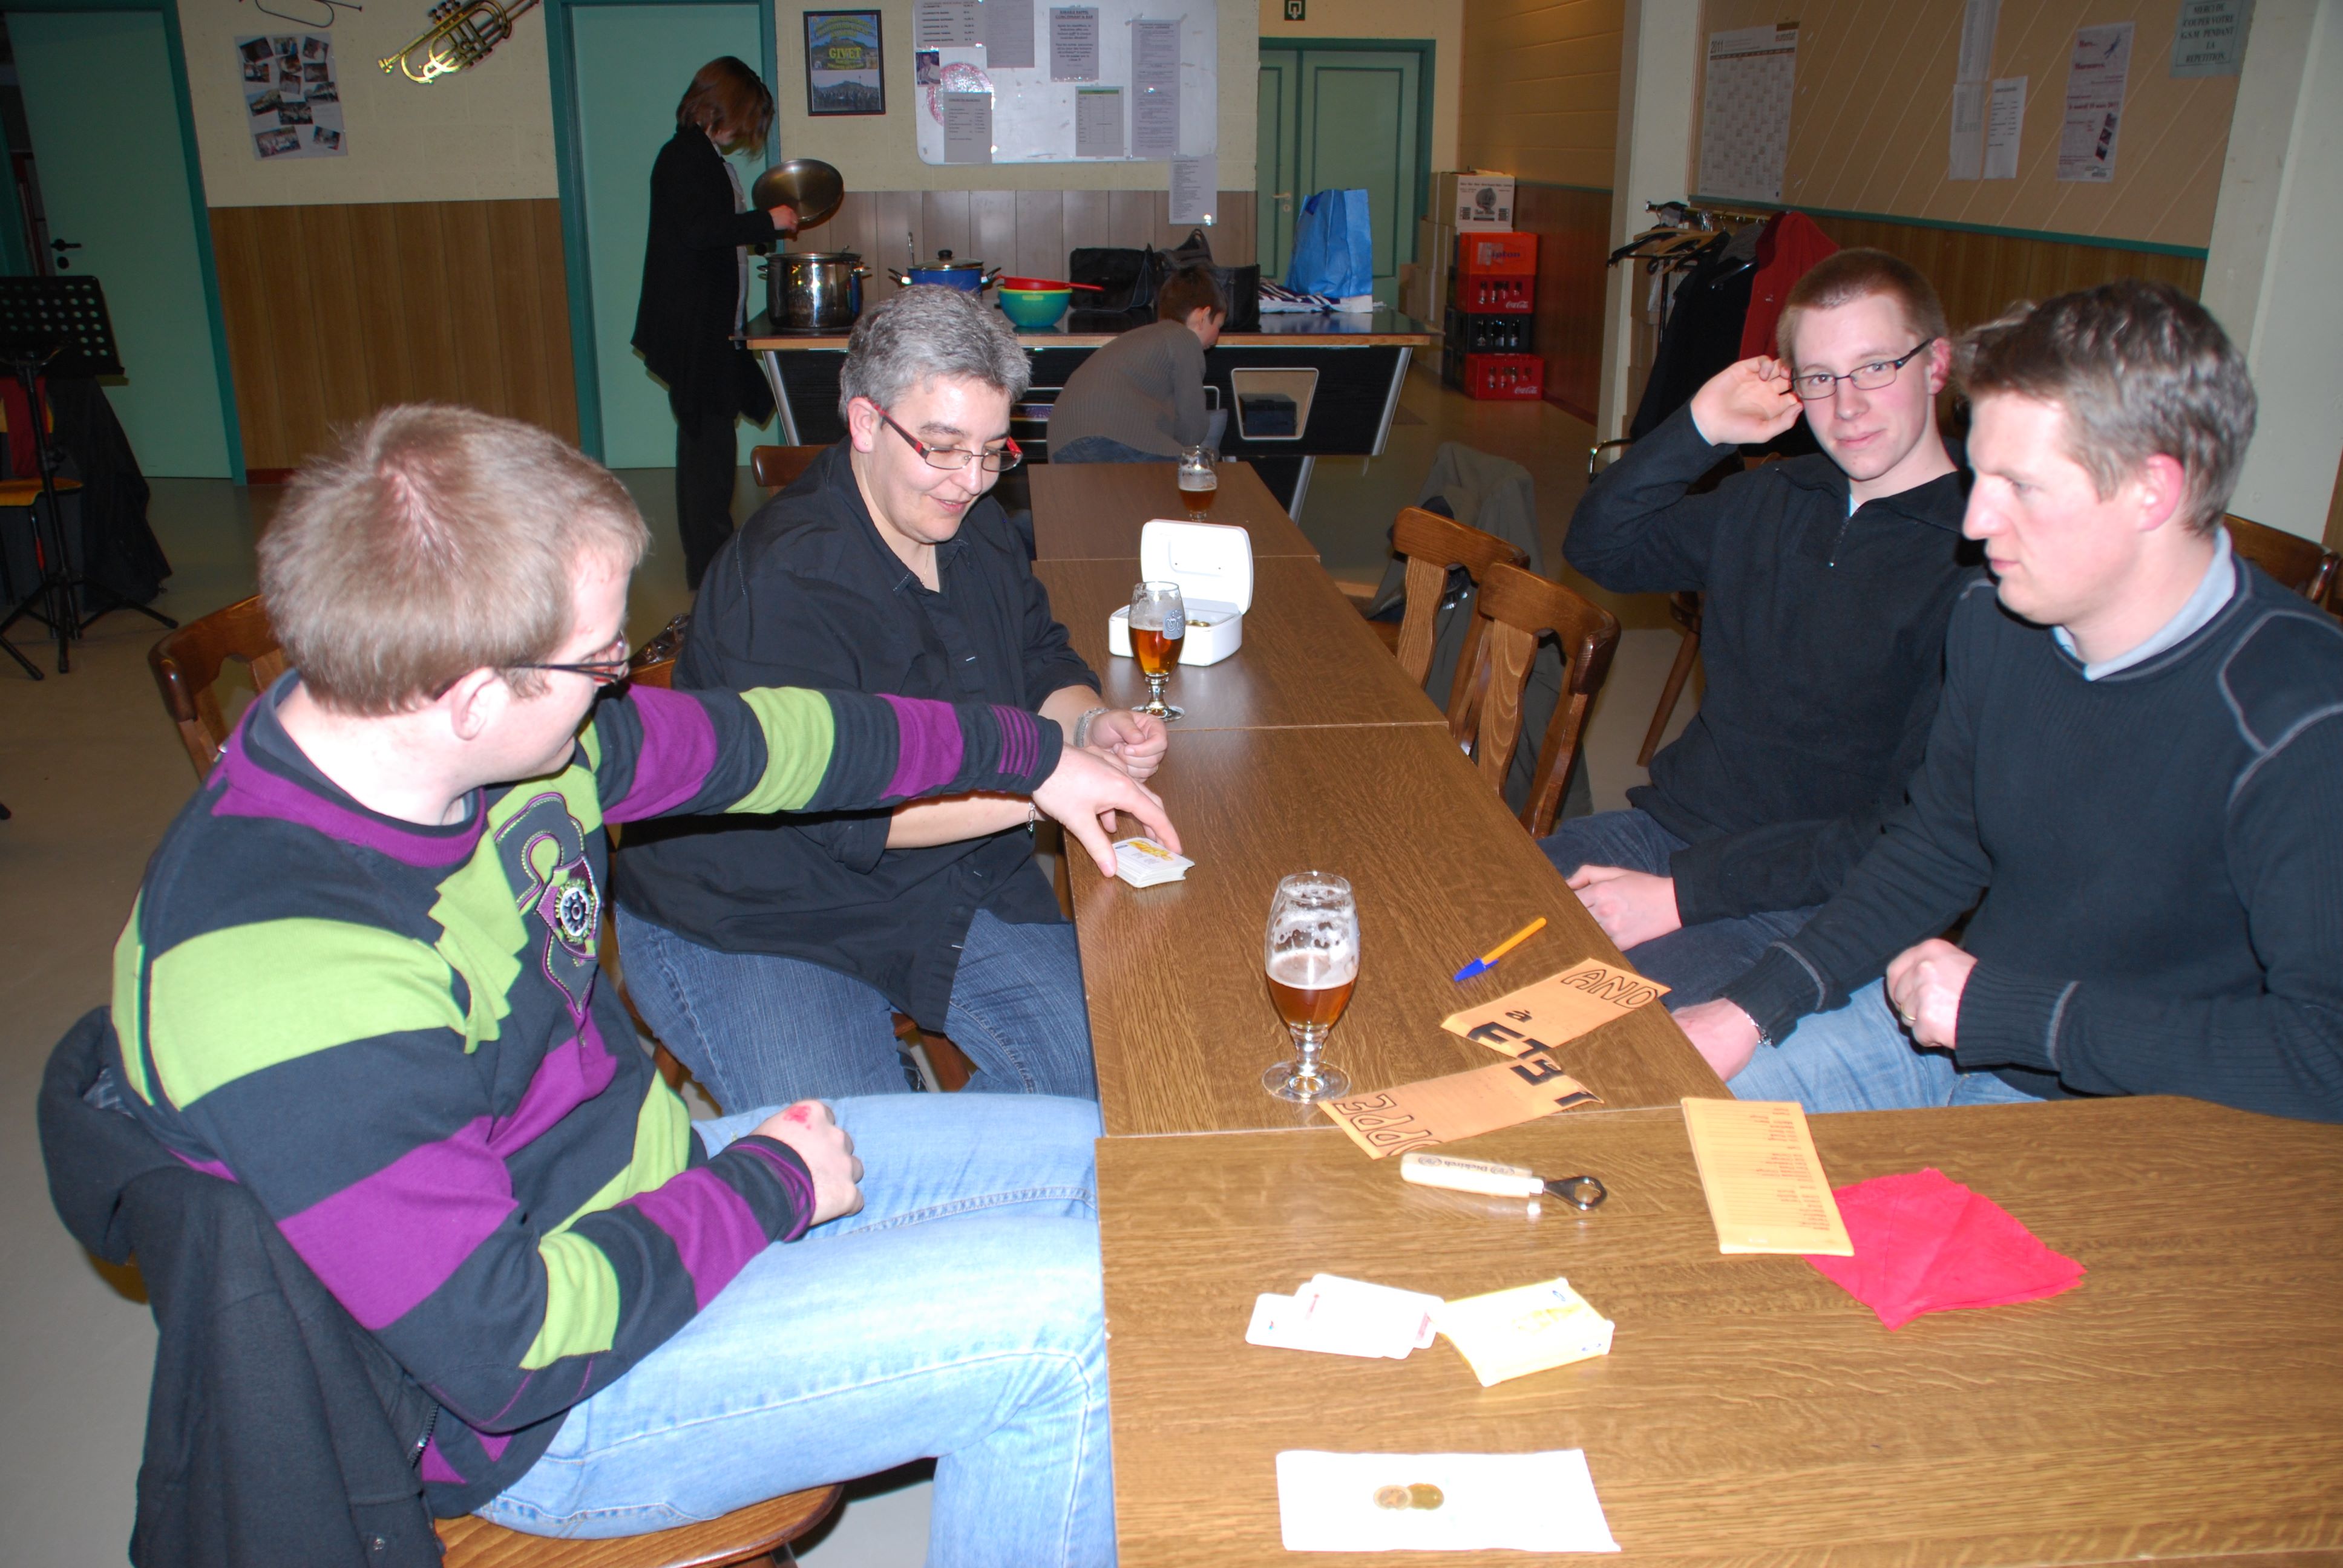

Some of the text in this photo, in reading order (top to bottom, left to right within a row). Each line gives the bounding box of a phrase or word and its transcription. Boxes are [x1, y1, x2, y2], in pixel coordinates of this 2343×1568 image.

[2194, 2, 2225, 15] MERCI DE
[2183, 14, 2234, 27] COUPER VOTRE
[2203, 26, 2234, 38] PENDANT
[1710, 39, 1724, 54] 2011
[1775, 31, 1796, 42] eurostat
[2205, 41, 2215, 50] LA
[828, 47, 862, 59] GIVET
[1444, 1160, 1488, 1172] Diekirch
